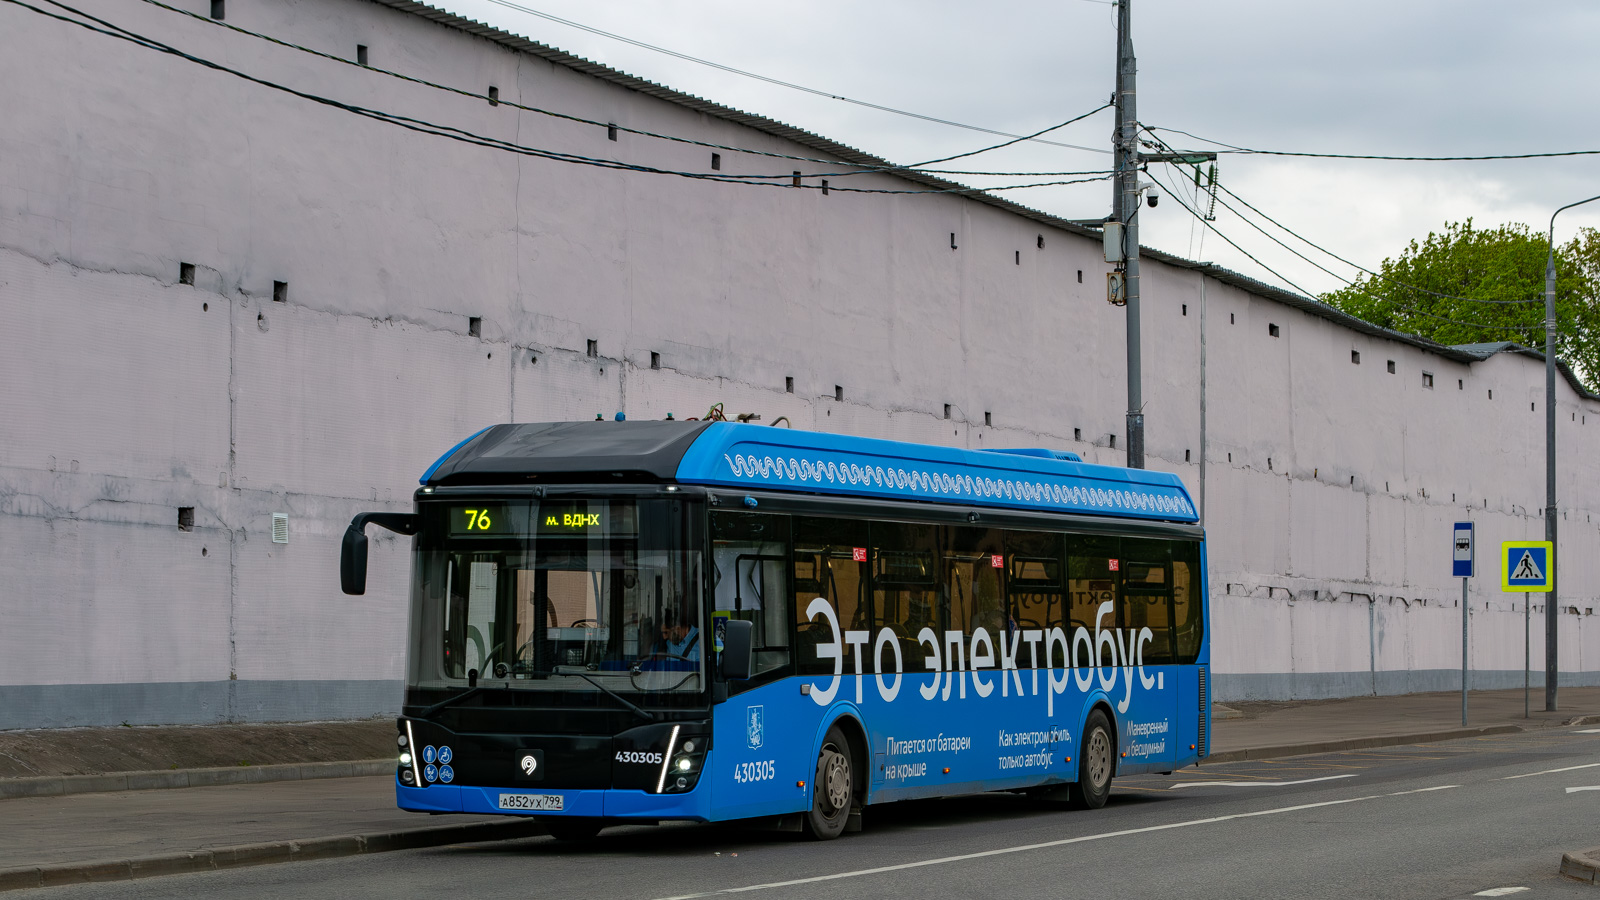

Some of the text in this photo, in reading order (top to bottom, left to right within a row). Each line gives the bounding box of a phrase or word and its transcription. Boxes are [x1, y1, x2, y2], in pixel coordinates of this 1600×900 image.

[465, 509, 491, 530] 76
[563, 514, 600, 527] ВДНХ
[805, 597, 1164, 717] Это электробус.
[999, 727, 1072, 749] Как электромобиль,
[1127, 717, 1169, 738] Маневренный
[886, 733, 971, 755] Питается от батареи
[1126, 738, 1165, 759] и бесшумный
[615, 751, 662, 764] 430305
[999, 748, 1053, 770] только автобус
[734, 760, 775, 783] 430305
[885, 762, 926, 782] на крыше
